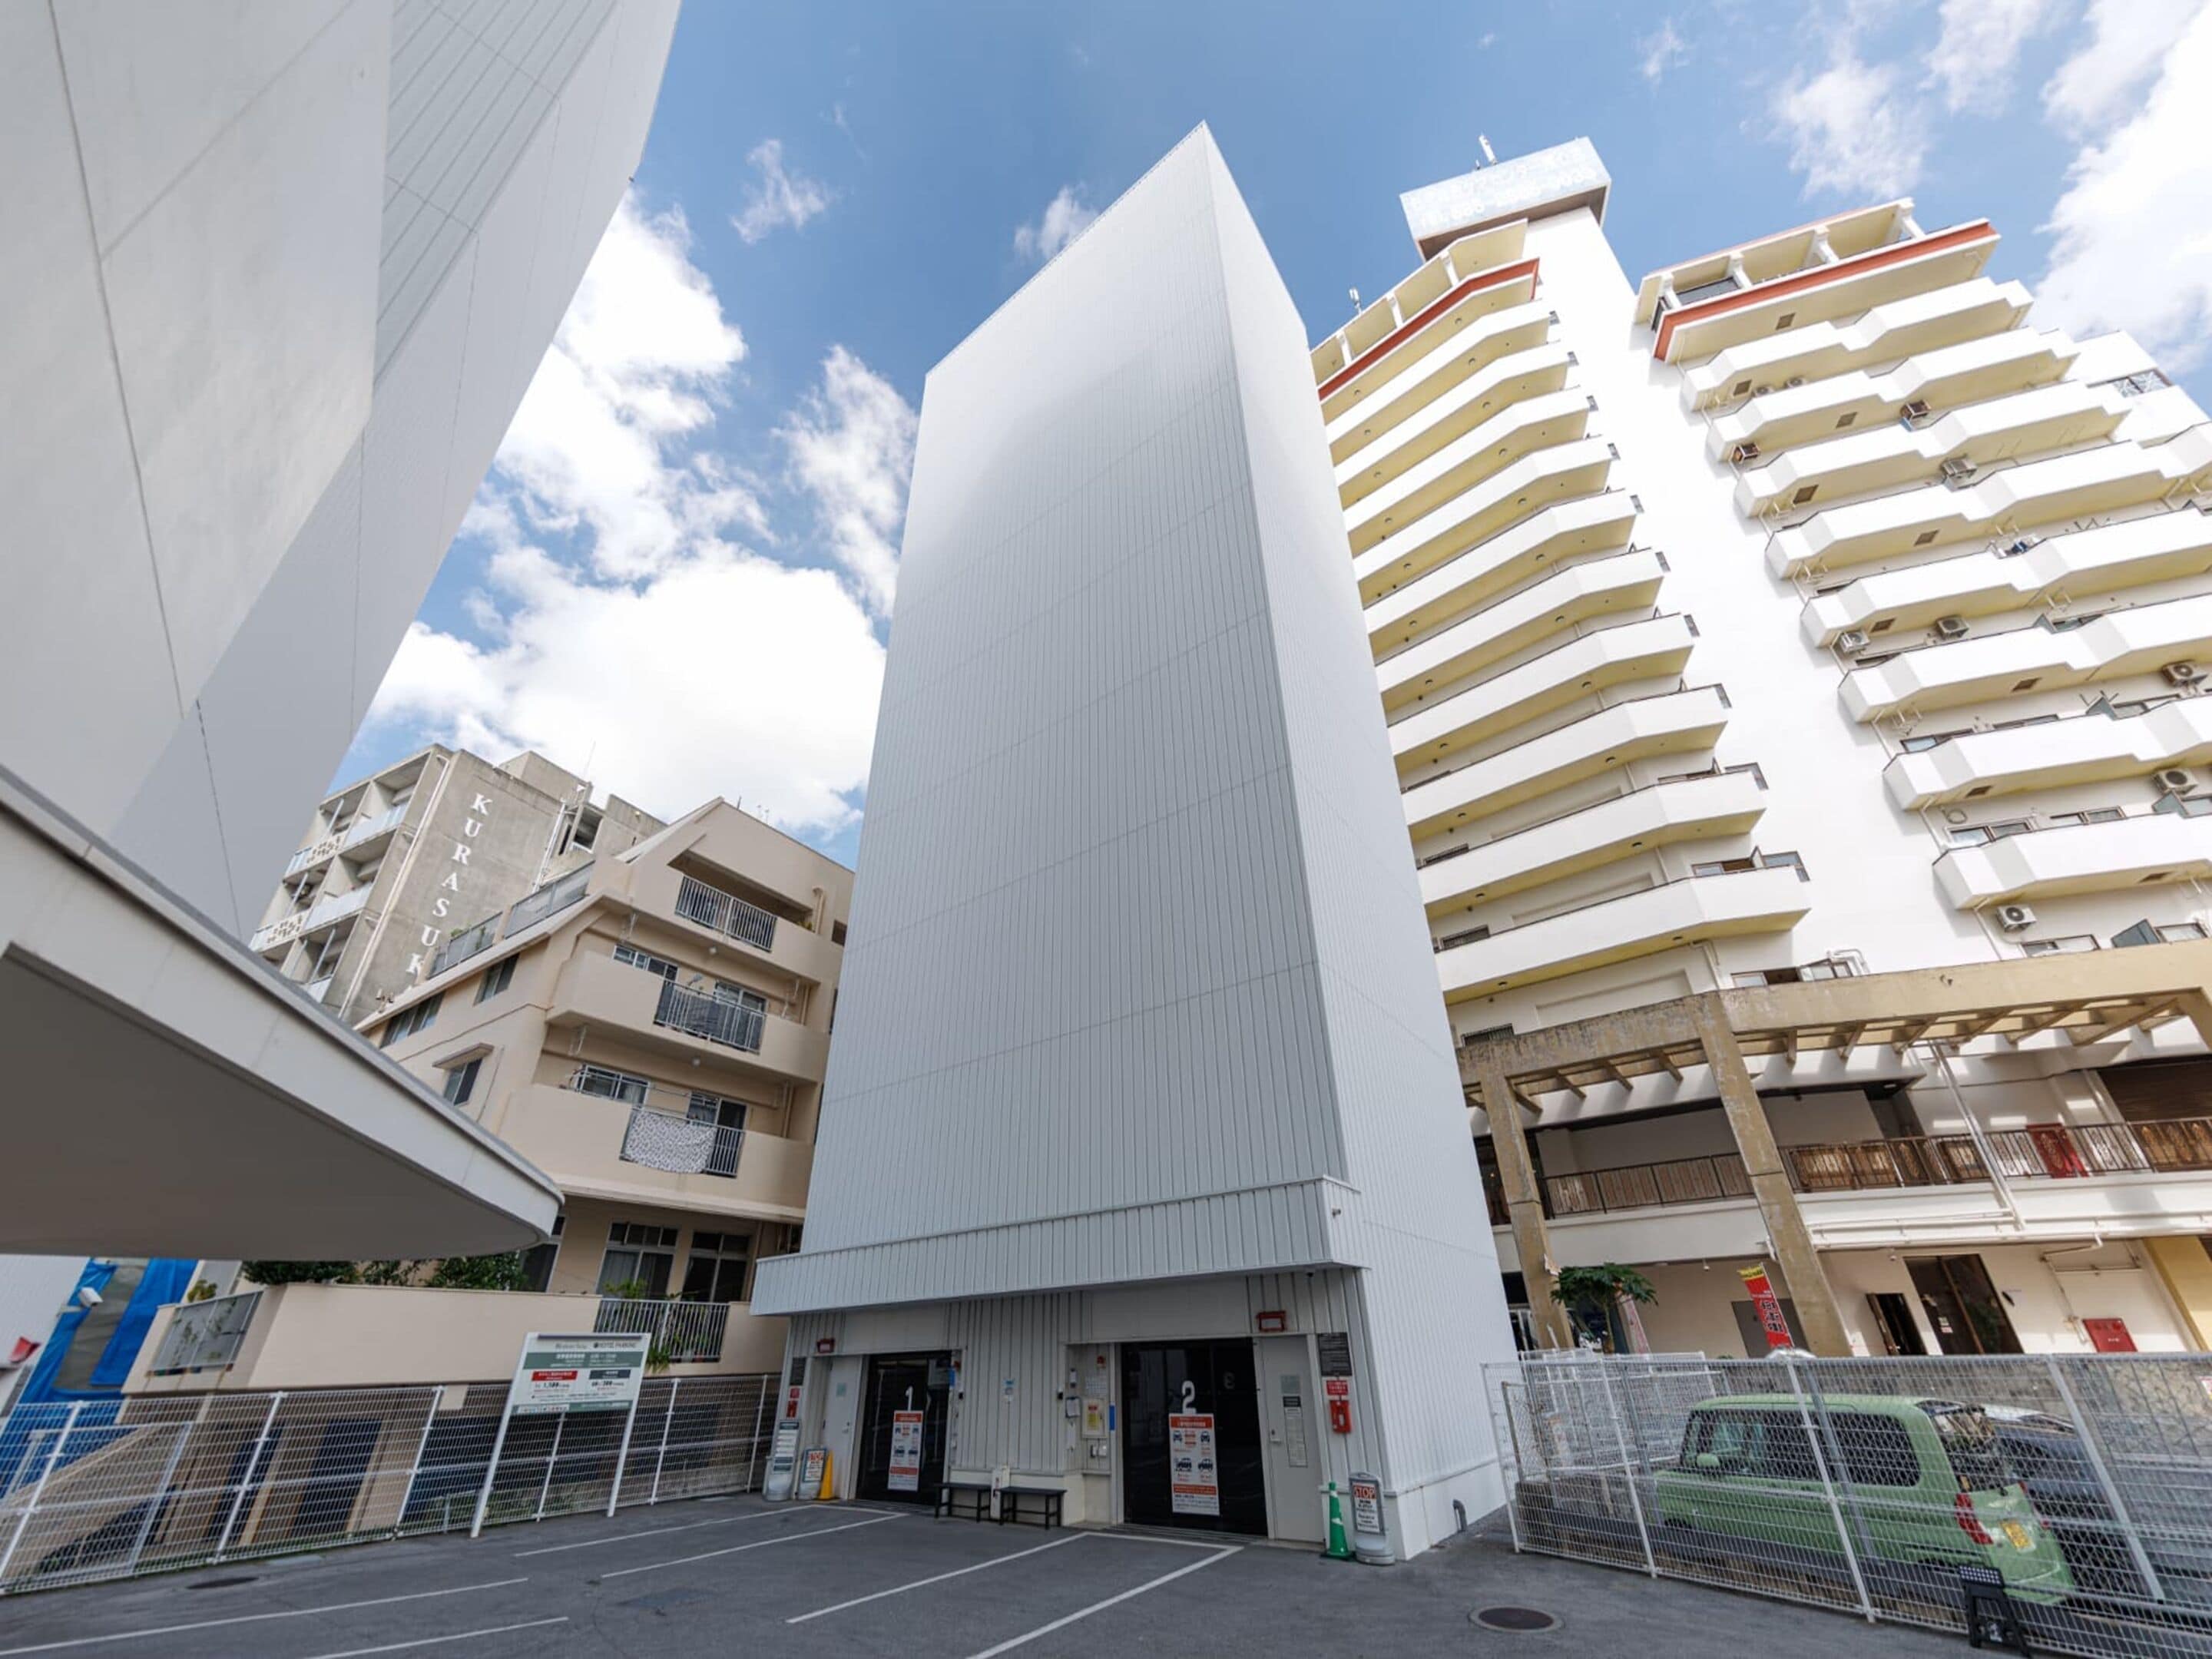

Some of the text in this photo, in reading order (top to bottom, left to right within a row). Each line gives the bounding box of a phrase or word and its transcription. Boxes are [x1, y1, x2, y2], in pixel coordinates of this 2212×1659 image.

[406, 792, 493, 991] KURASUK
[905, 1386, 913, 1411] 1
[1181, 1380, 1197, 1413] 2
[1353, 1485, 1376, 1499] STOP
